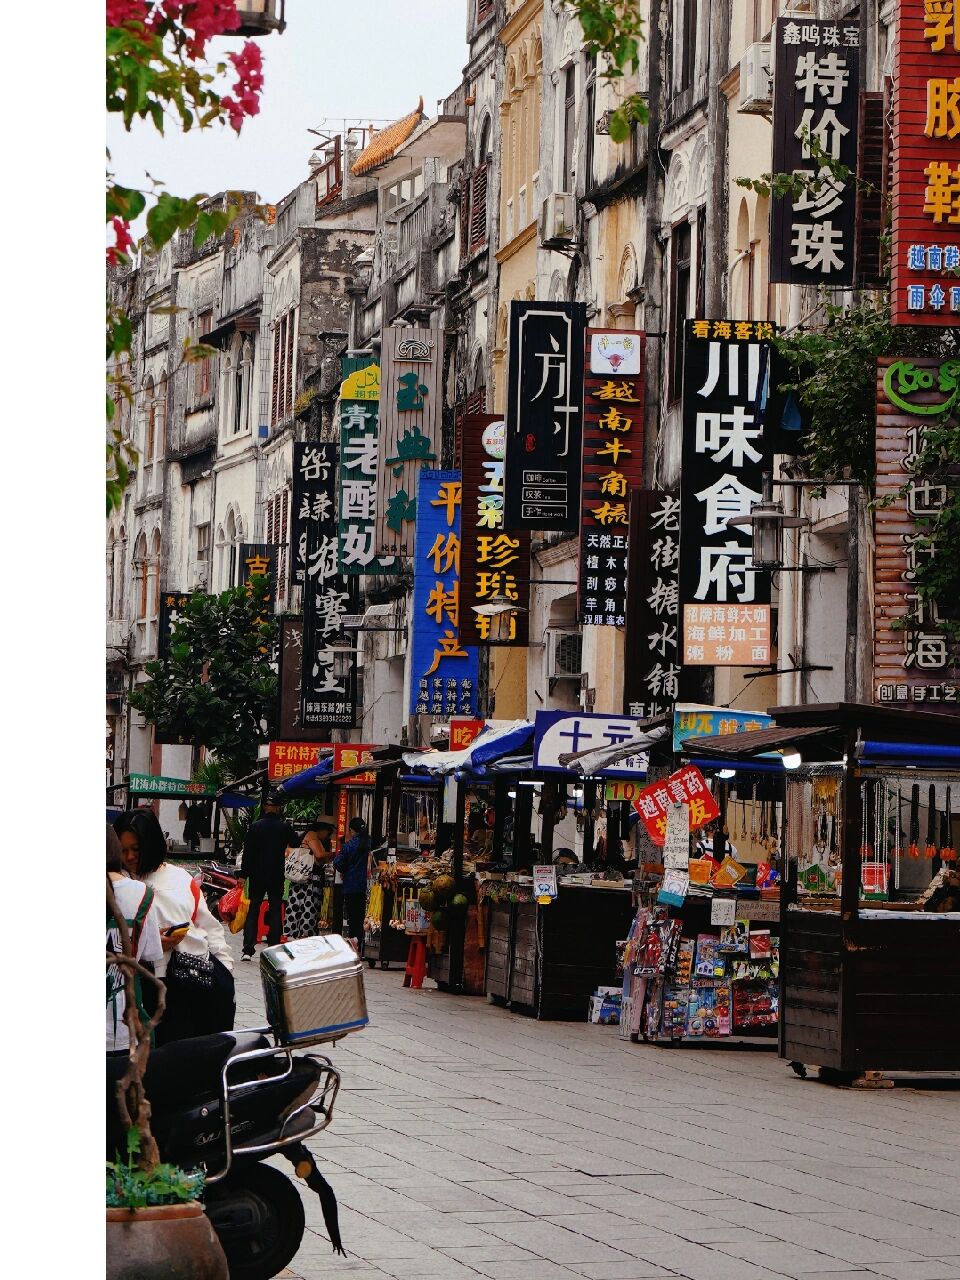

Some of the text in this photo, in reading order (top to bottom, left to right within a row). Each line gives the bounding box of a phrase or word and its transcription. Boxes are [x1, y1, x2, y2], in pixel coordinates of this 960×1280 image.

[782, 21, 860, 47] 鑫鸣珠宝
[790, 51, 850, 273] 特价珍珠
[907, 245, 960, 270] 越南鞋
[691, 320, 774, 340] 看海客栈
[343, 404, 379, 430] 青
[592, 380, 641, 525] 越南牛角梳
[694, 342, 763, 603] 川味食府
[587, 534, 629, 548] 天然正
[586, 555, 628, 570] 檀木
[425, 481, 469, 677] 平价特产
[586, 577, 627, 591] 刮痧
[585, 598, 626, 612] 羊角
[643, 495, 681, 699] 老街糖水铺
[687, 625, 768, 641] 海鲜加工
[275, 746, 319, 761] 平价特产
[611, 783, 645, 801] 10
[640, 771, 703, 819] 越南膏药
